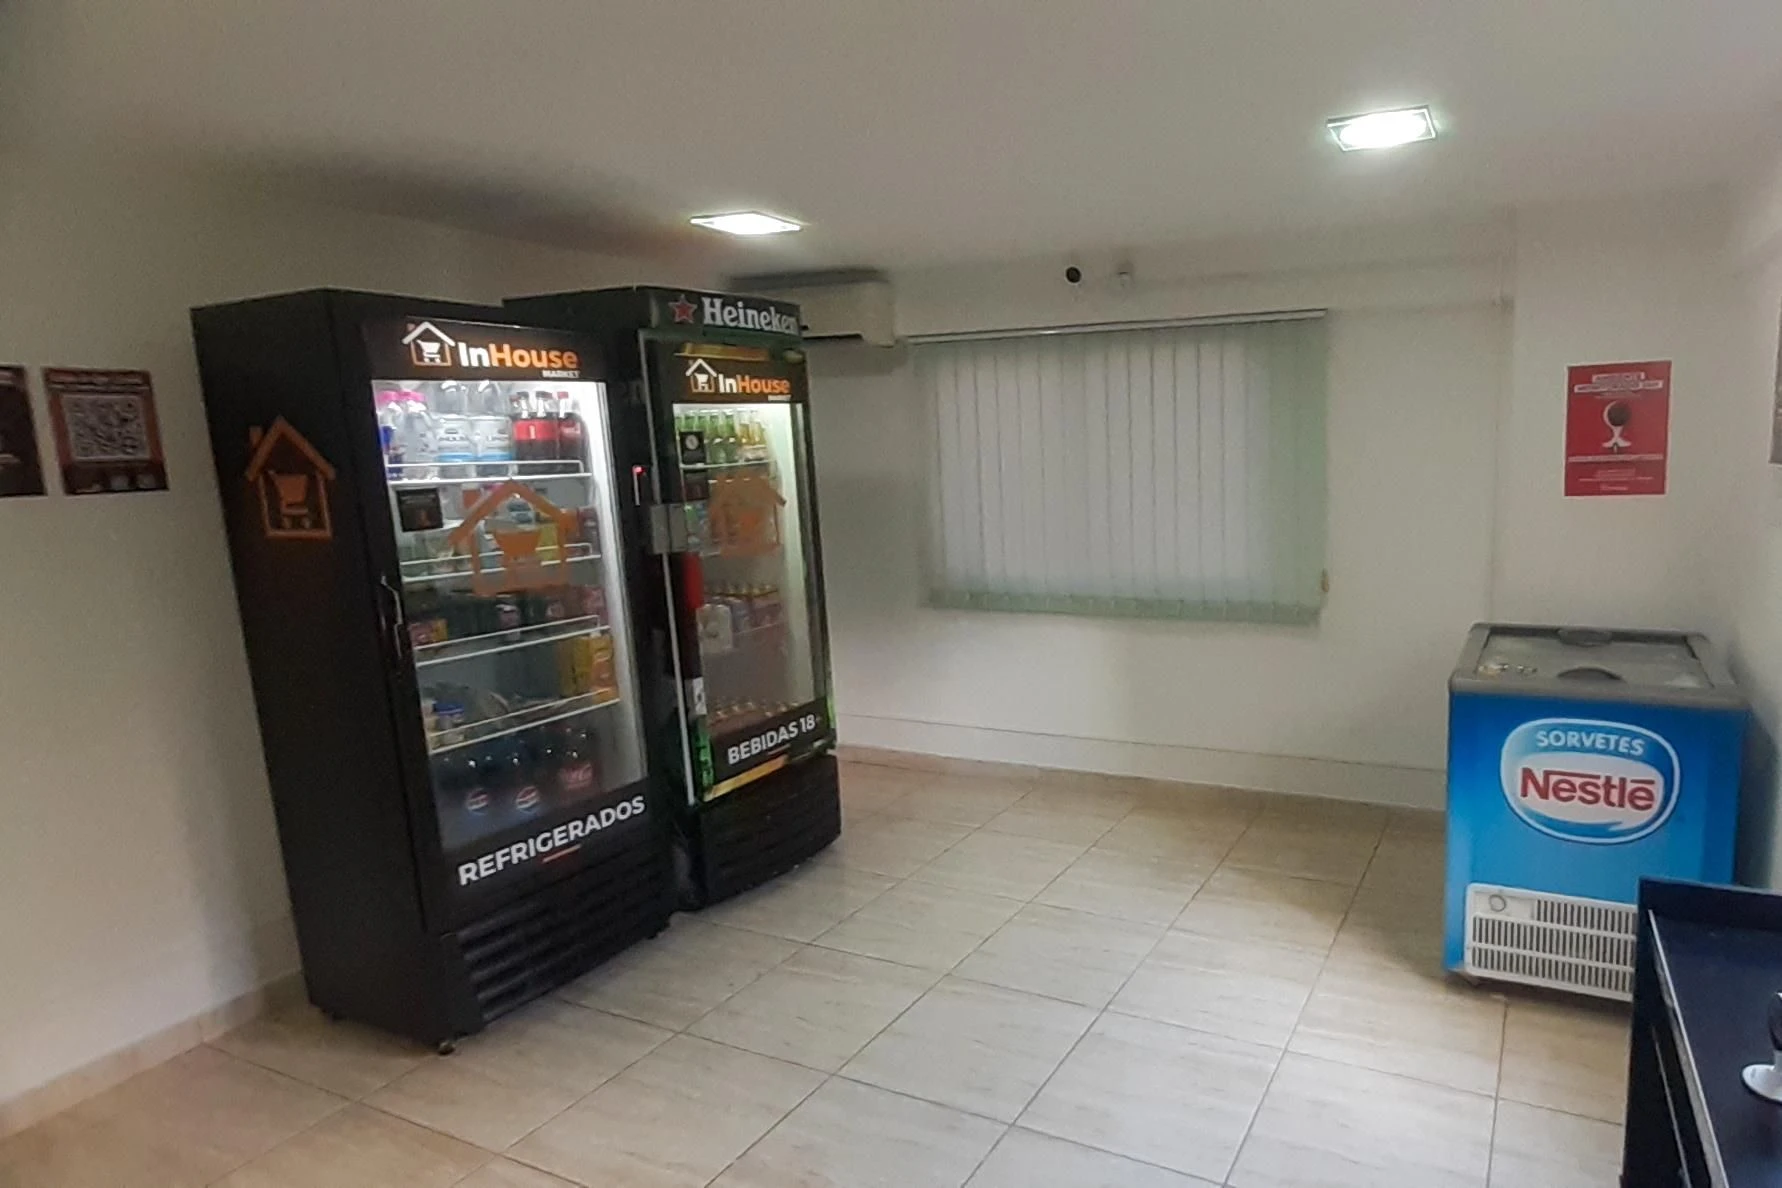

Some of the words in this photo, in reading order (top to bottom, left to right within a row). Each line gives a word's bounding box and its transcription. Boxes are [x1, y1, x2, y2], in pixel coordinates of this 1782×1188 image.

[701, 296, 799, 336] Heineken
[457, 341, 578, 369] InHouse
[718, 373, 791, 394] InHouse
[727, 721, 799, 765] BEBIDAS
[1535, 729, 1646, 756] SORVETES
[457, 795, 646, 886] REFRIGERADOS
